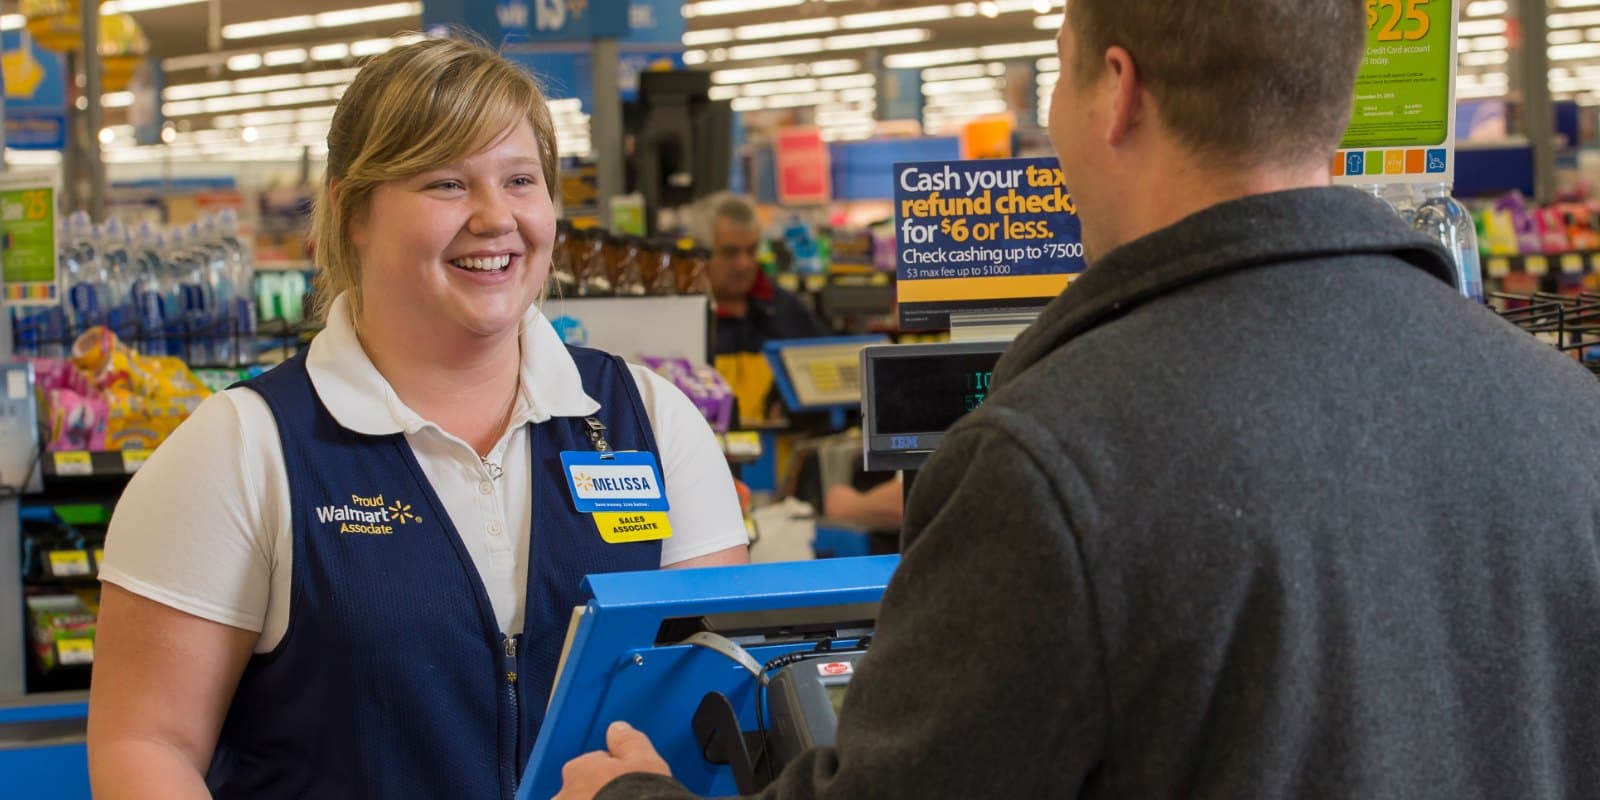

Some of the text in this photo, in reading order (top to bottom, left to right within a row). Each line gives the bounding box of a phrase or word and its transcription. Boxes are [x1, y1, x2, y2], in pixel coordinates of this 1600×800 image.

[1387, 45, 1403, 54] Card
[900, 165, 1067, 196] Cash your tax
[902, 188, 991, 218] refund
[902, 215, 1055, 244] for $6 or less.
[903, 243, 1084, 264] Check cashing up to $7500
[906, 264, 1011, 278] $3 max fee up to $1000
[891, 436, 919, 449] IBM
[592, 477, 650, 491] MELISSA
[351, 494, 384, 507] Proud
[316, 505, 390, 524] Walmart
[618, 516, 645, 525] SALES
[340, 523, 393, 534] Associate
[613, 523, 658, 534] ASSOCIATE
